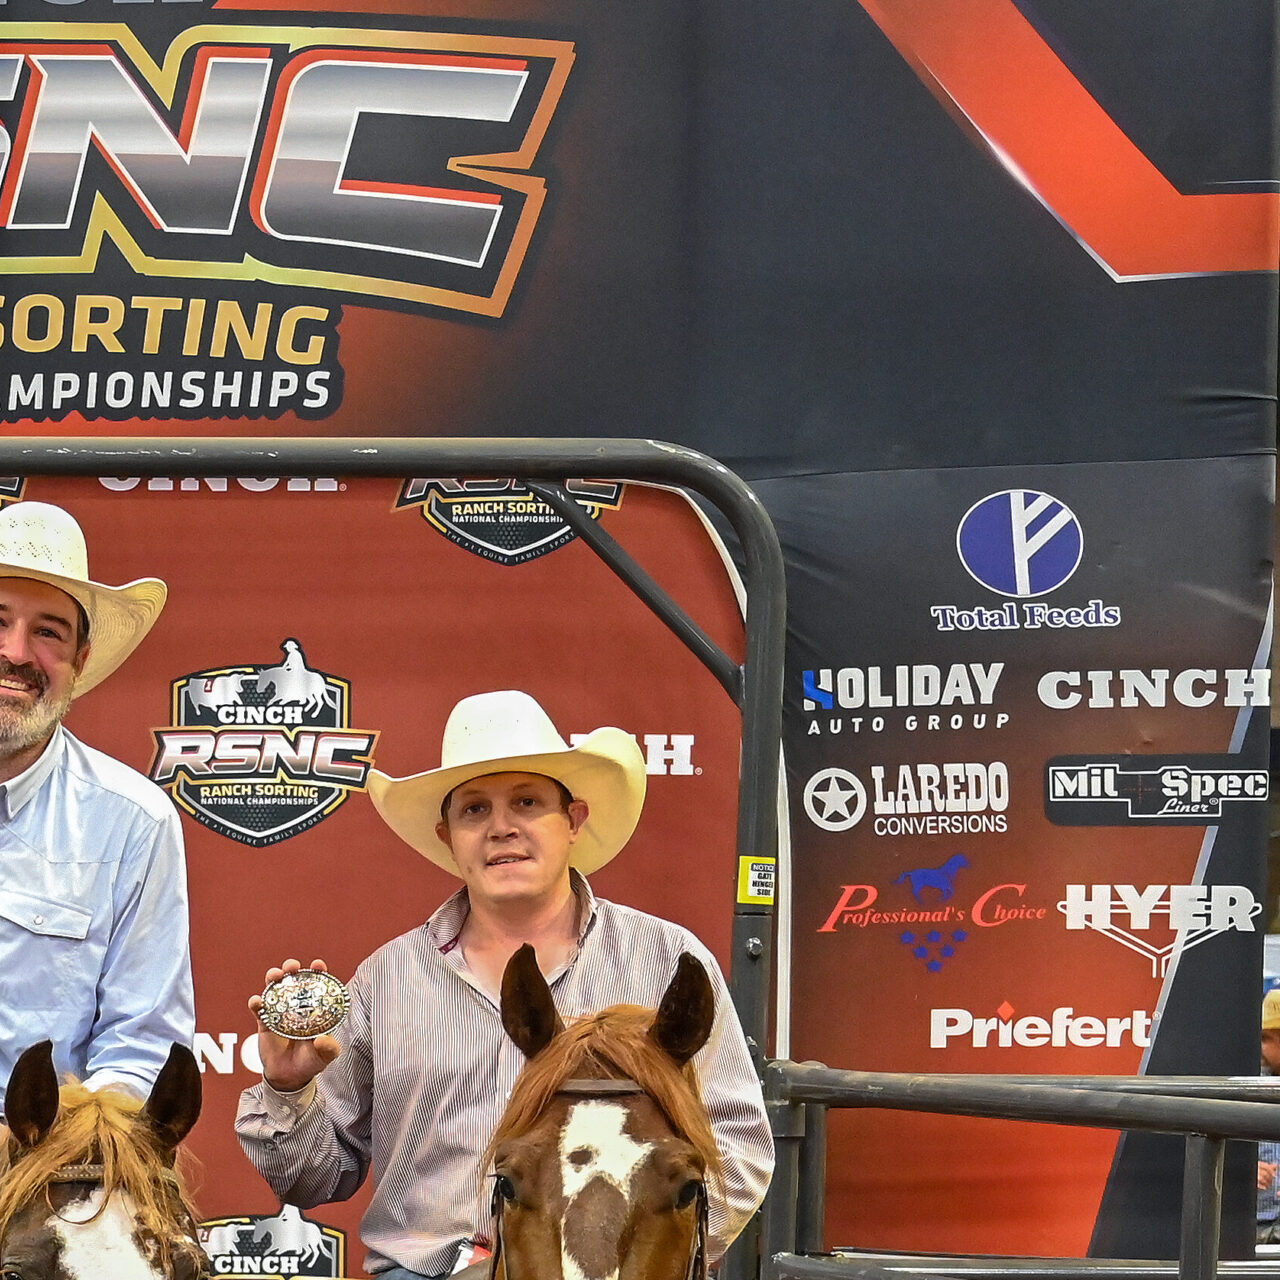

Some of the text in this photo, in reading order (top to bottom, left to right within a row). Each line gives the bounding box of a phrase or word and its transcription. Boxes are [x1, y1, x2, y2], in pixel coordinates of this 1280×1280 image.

[452, 502, 504, 515] RANCH
[452, 515, 496, 523] NATIONAL
[930, 601, 1120, 631] Total Feeds
[803, 663, 1005, 711] HOLIDAY
[1037, 668, 1272, 709] CINCH
[217, 705, 304, 724] CINCH
[808, 713, 1010, 735] AUTO GROUP
[154, 731, 370, 782] RSNC
[200, 784, 319, 798] RANCH SORTING
[871, 761, 1009, 815] LAREDO
[1053, 770, 1269, 800] Mil Spec
[200, 797, 319, 805] NATIONAL CHAMPIONSHIPS
[1155, 798, 1210, 815] Liner
[873, 814, 1008, 836] CONVERSIONS
[816, 883, 1047, 932] Professional's Choice
[1065, 884, 1257, 932] HYER
[930, 1001, 1152, 1049] Priefert
[214, 1256, 300, 1274] CINCH
